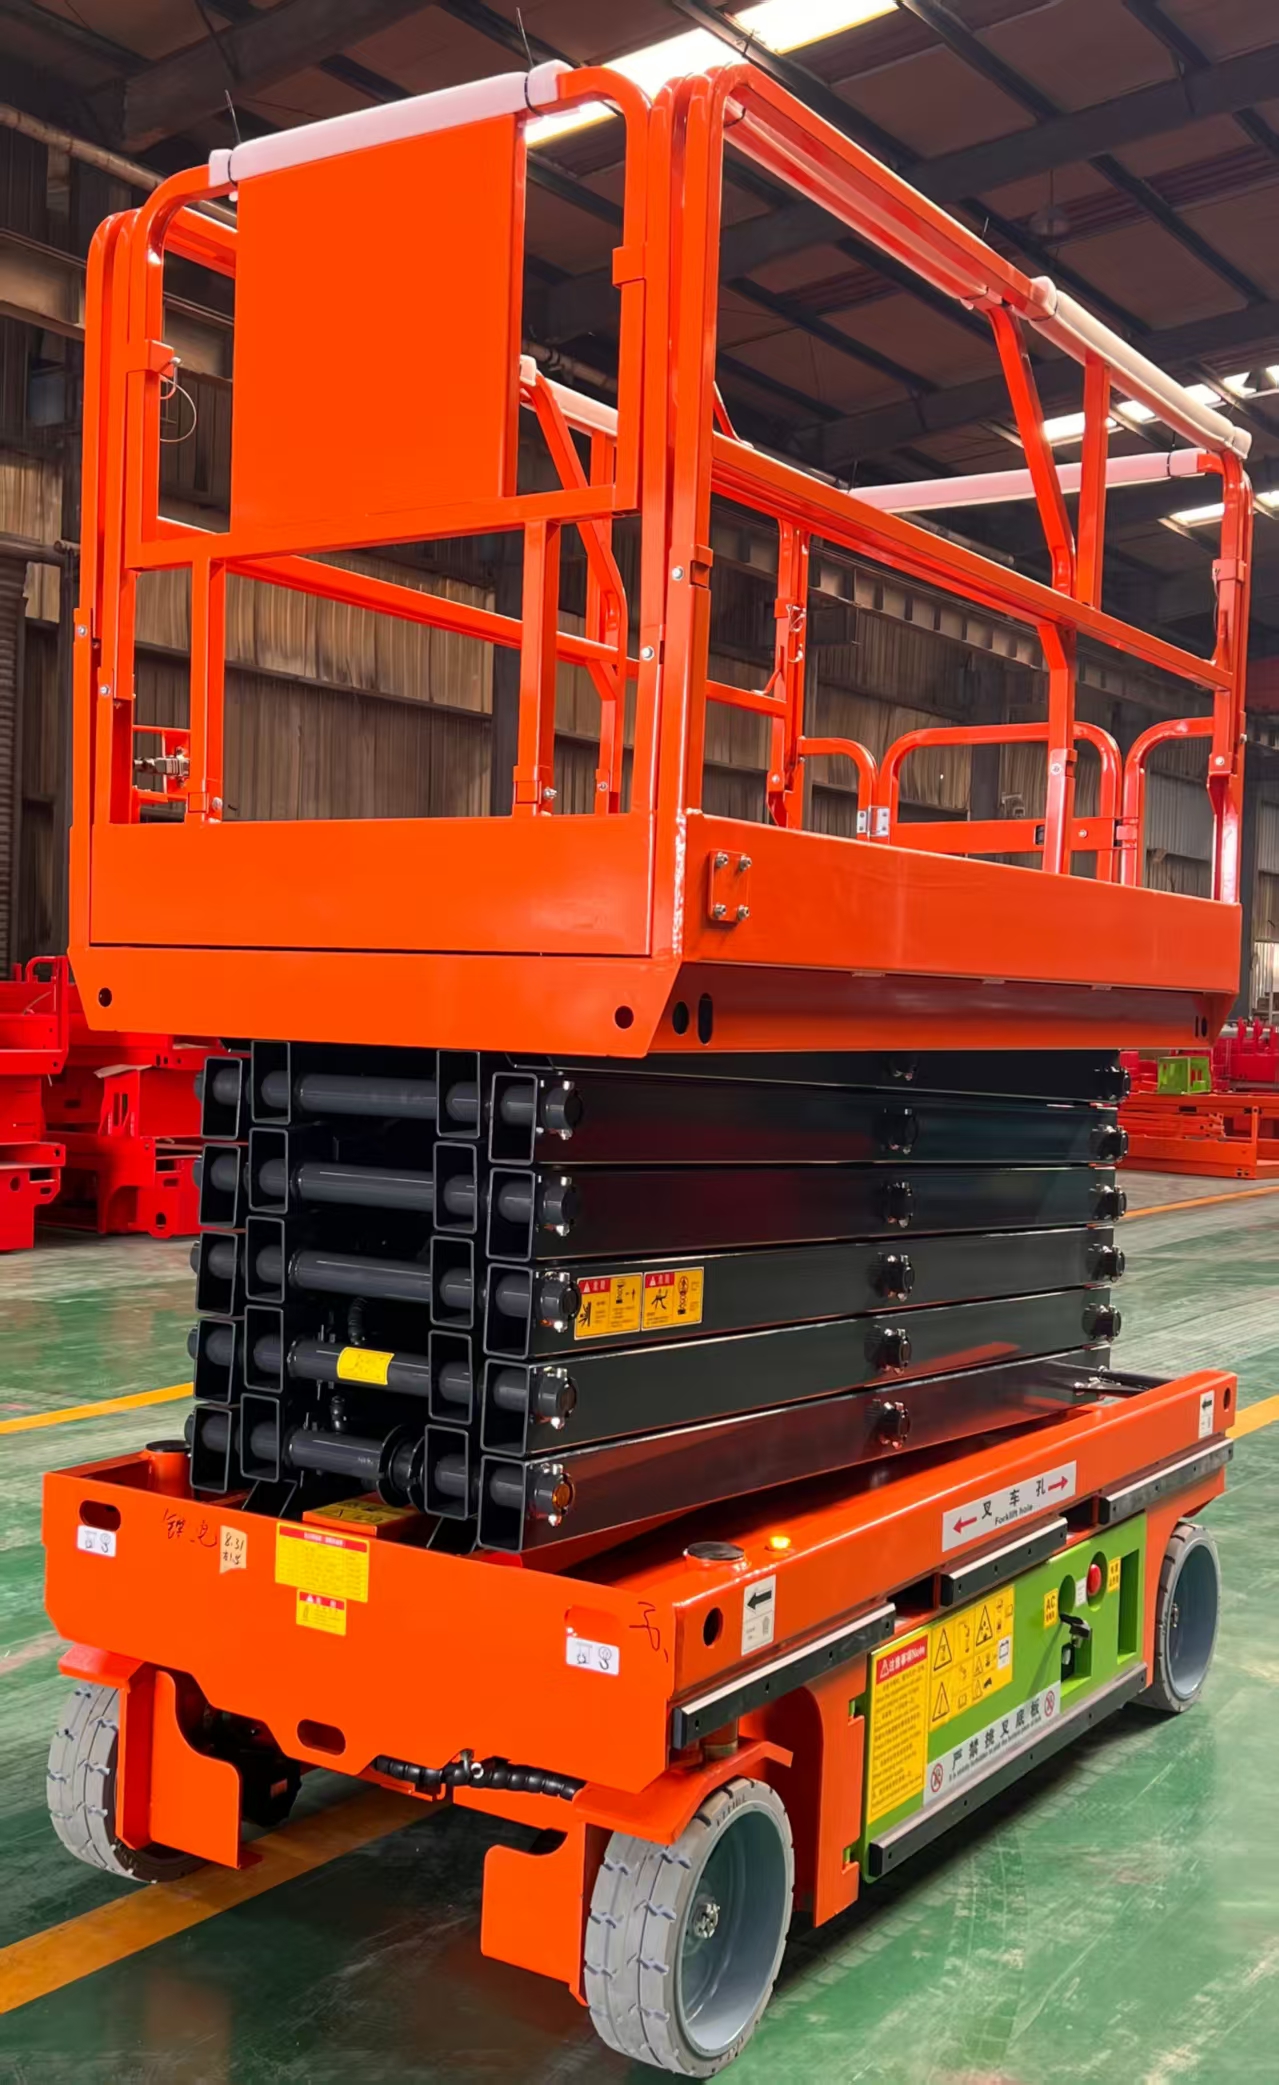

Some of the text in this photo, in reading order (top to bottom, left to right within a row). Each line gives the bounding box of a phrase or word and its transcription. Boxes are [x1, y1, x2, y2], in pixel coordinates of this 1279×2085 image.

[982, 1477, 1046, 1520] 叉车孔
[995, 1504, 1033, 1526] Forklift hole
[1046, 1595, 1056, 1610] AC
[952, 1698, 1039, 1771] 严禁挑叉底板
